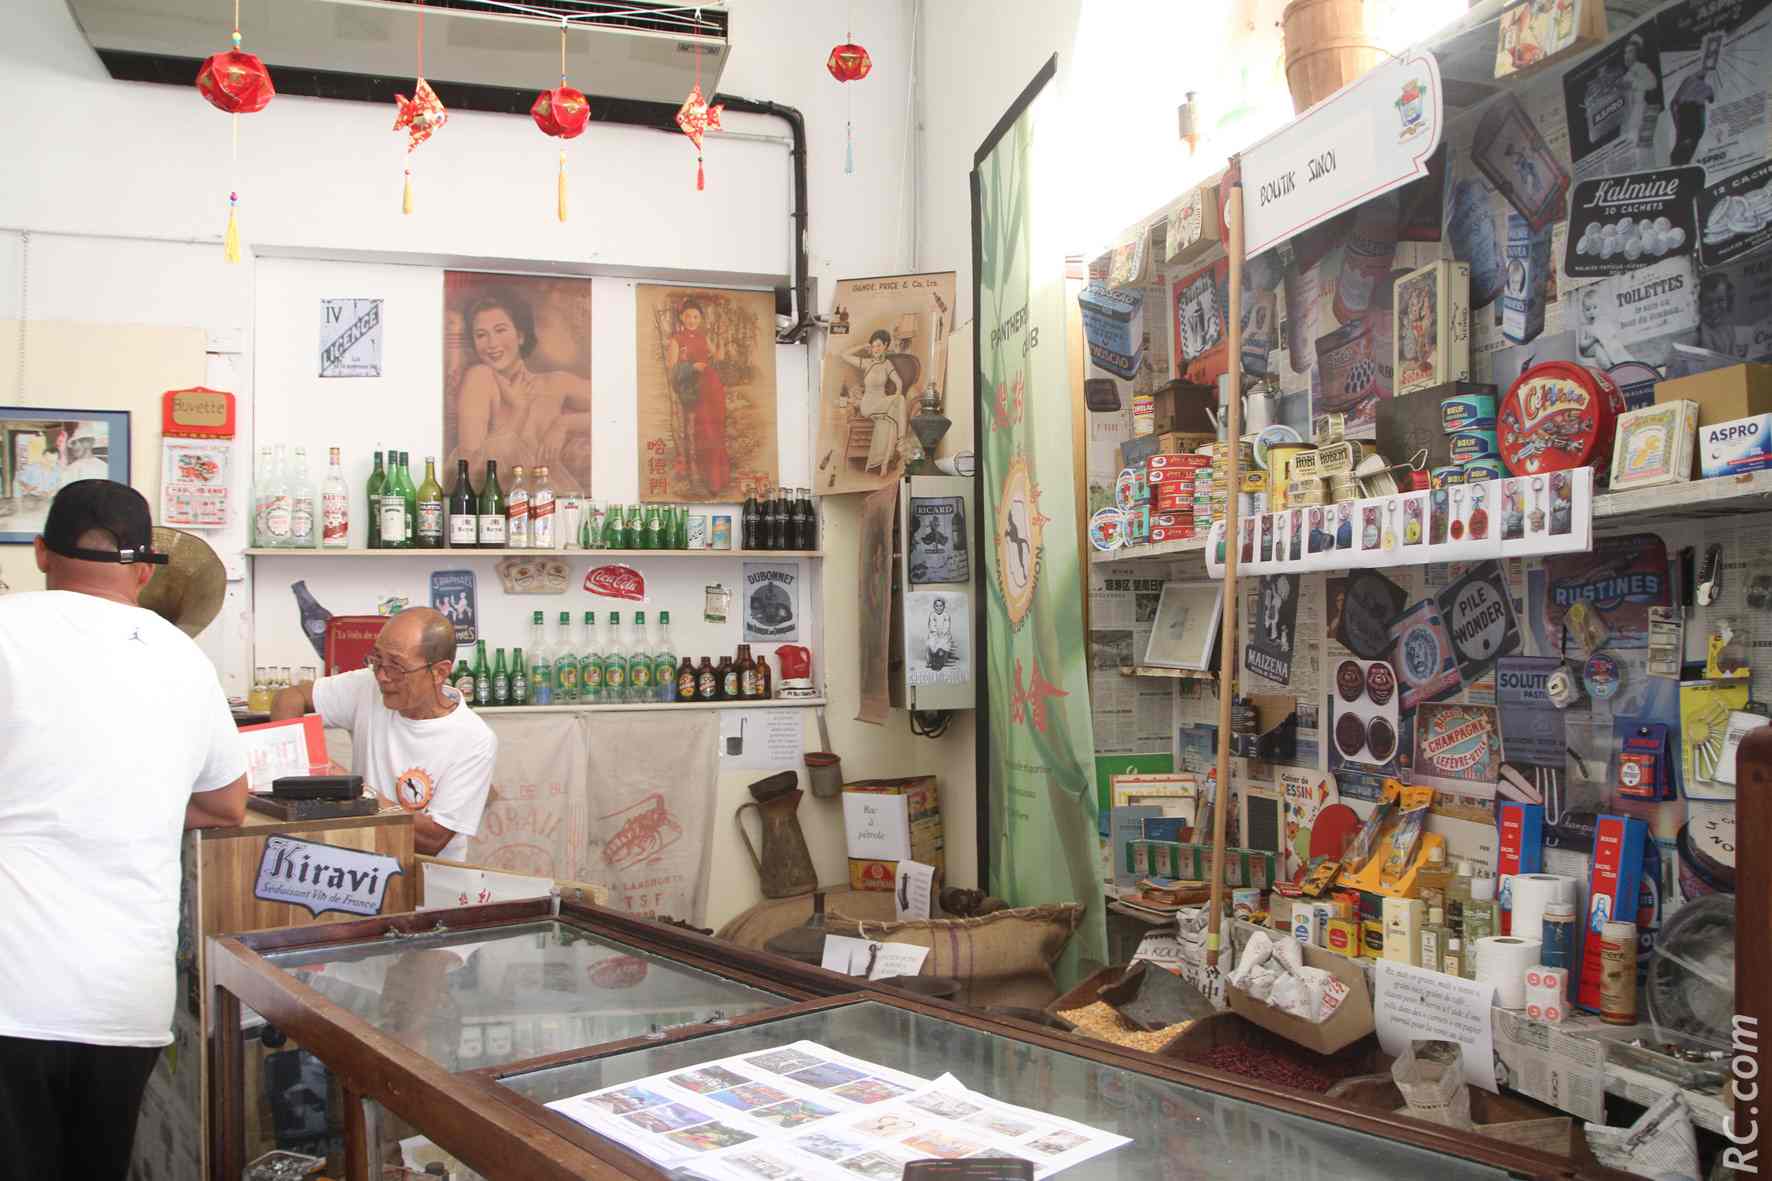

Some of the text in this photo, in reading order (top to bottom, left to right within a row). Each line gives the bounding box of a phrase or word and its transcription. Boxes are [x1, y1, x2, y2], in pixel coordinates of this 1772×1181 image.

[1260, 150, 1337, 207] BOUTIK SINOI
[1584, 175, 1681, 208] Kalmine
[1621, 200, 1664, 214] CACHETS
[1616, 274, 1684, 308] TOILETTES
[326, 306, 342, 323] IV
[321, 304, 379, 372] LICENCE
[173, 398, 225, 416] Buvette
[1709, 422, 1760, 444] ASPRO
[1320, 448, 1347, 465] ROBERT
[917, 505, 954, 515] RICARD
[590, 569, 641, 592] Coca-Cola
[747, 569, 796, 586] DUBONNET
[1555, 575, 1660, 606] RUSTINES
[1459, 586, 1488, 617] PILE
[1454, 600, 1505, 644] WONDER
[1248, 648, 1289, 680] MAIZENA
[1428, 717, 1490, 753] CHAMPAGNE
[267, 846, 380, 894] Kiravi
[330, 893, 342, 902] de
[343, 893, 377, 908] France
